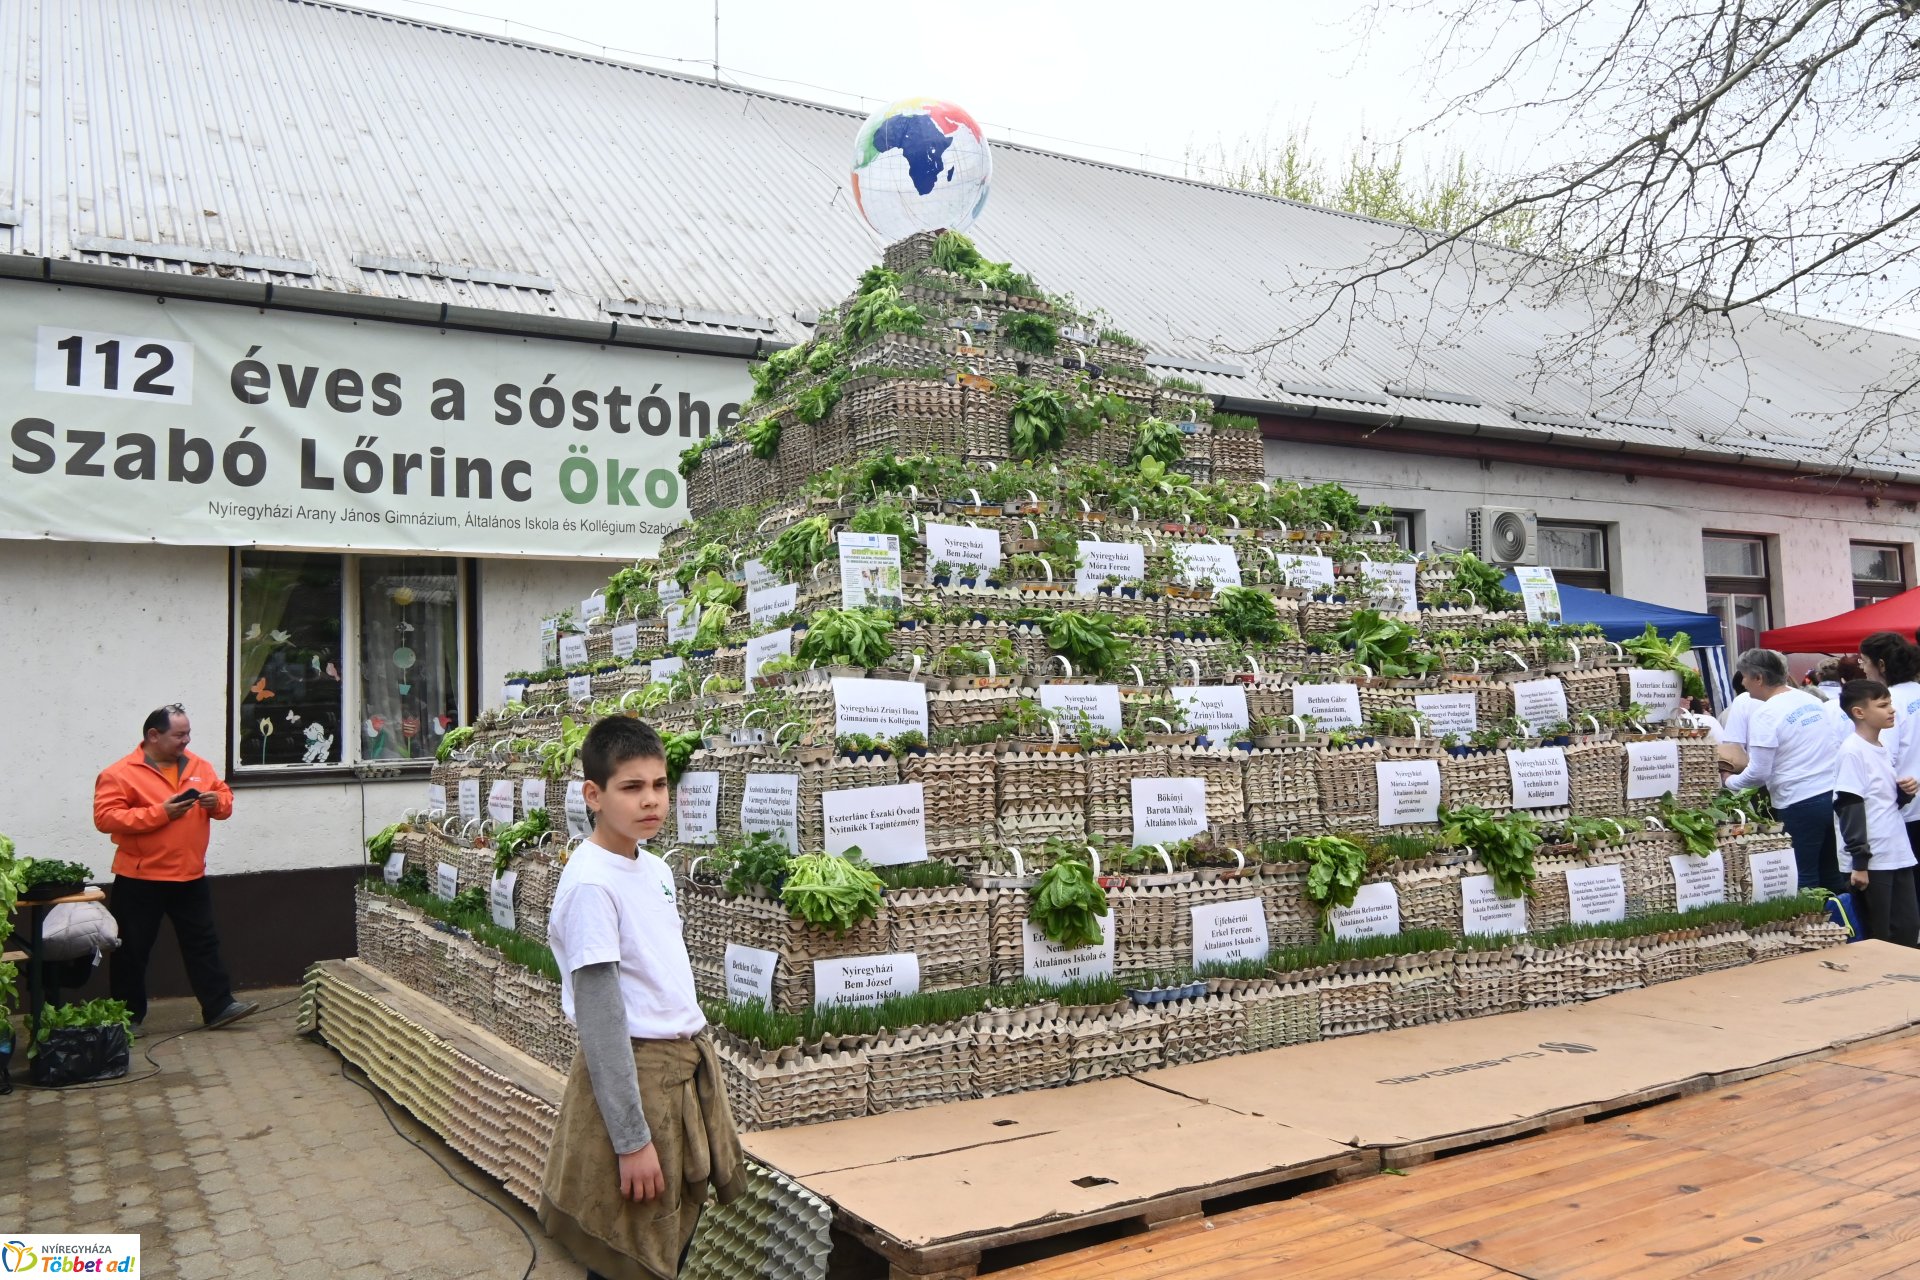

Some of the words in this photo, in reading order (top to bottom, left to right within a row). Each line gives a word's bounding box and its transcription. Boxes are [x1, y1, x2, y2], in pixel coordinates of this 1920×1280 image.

[57, 335, 176, 395] 112
[230, 346, 403, 414] éves
[431, 379, 467, 420] a
[11, 416, 268, 487] Szabó
[299, 434, 532, 502] Lőrinc
[208, 501, 293, 520] Nyíregyházi
[297, 505, 336, 523] Arany
[340, 508, 380, 524] János
[385, 510, 461, 528] Gimnázium,
[465, 511, 521, 530] Általános
[525, 517, 559, 531] Iskola
[563, 517, 577, 532] és
[581, 518, 636, 536] Kollégium
[639, 521, 674, 535] Szabó
[947, 549, 960, 557] Bem
[840, 704, 879, 714] Nyíregyházi
[881, 706, 900, 716] Zrínyi
[902, 707, 919, 716] Ilona
[840, 714, 879, 723] Gimnázium
[888, 715, 921, 726] Kollégium
[1157, 793, 1183, 803] Bökönyi
[829, 812, 868, 824] Eszterlánc
[870, 808, 895, 819] Északi
[896, 806, 920, 816] Óvoda
[1172, 805, 1194, 815] Mihály
[830, 823, 868, 836] Nyitnikék
[869, 818, 920, 831] Tagintézmény
[1145, 816, 1177, 827] Általános
[1178, 818, 1198, 826] Iskola
[1214, 914, 1248, 927] Újfehértói
[1211, 930, 1229, 938] Erkel
[1230, 926, 1253, 936] Ferenc
[1203, 939, 1233, 951] Általános
[1234, 936, 1254, 946] Iskola
[1033, 957, 1072, 969] Általános
[1073, 953, 1097, 963] Iskola
[1098, 951, 1106, 959] és
[1225, 949, 1241, 959] AMI
[842, 964, 893, 977] Nyíregyházi
[1061, 967, 1080, 979] AMI
[844, 980, 864, 990] Bem
[866, 977, 892, 988] József
[833, 991, 874, 1003] Általános
